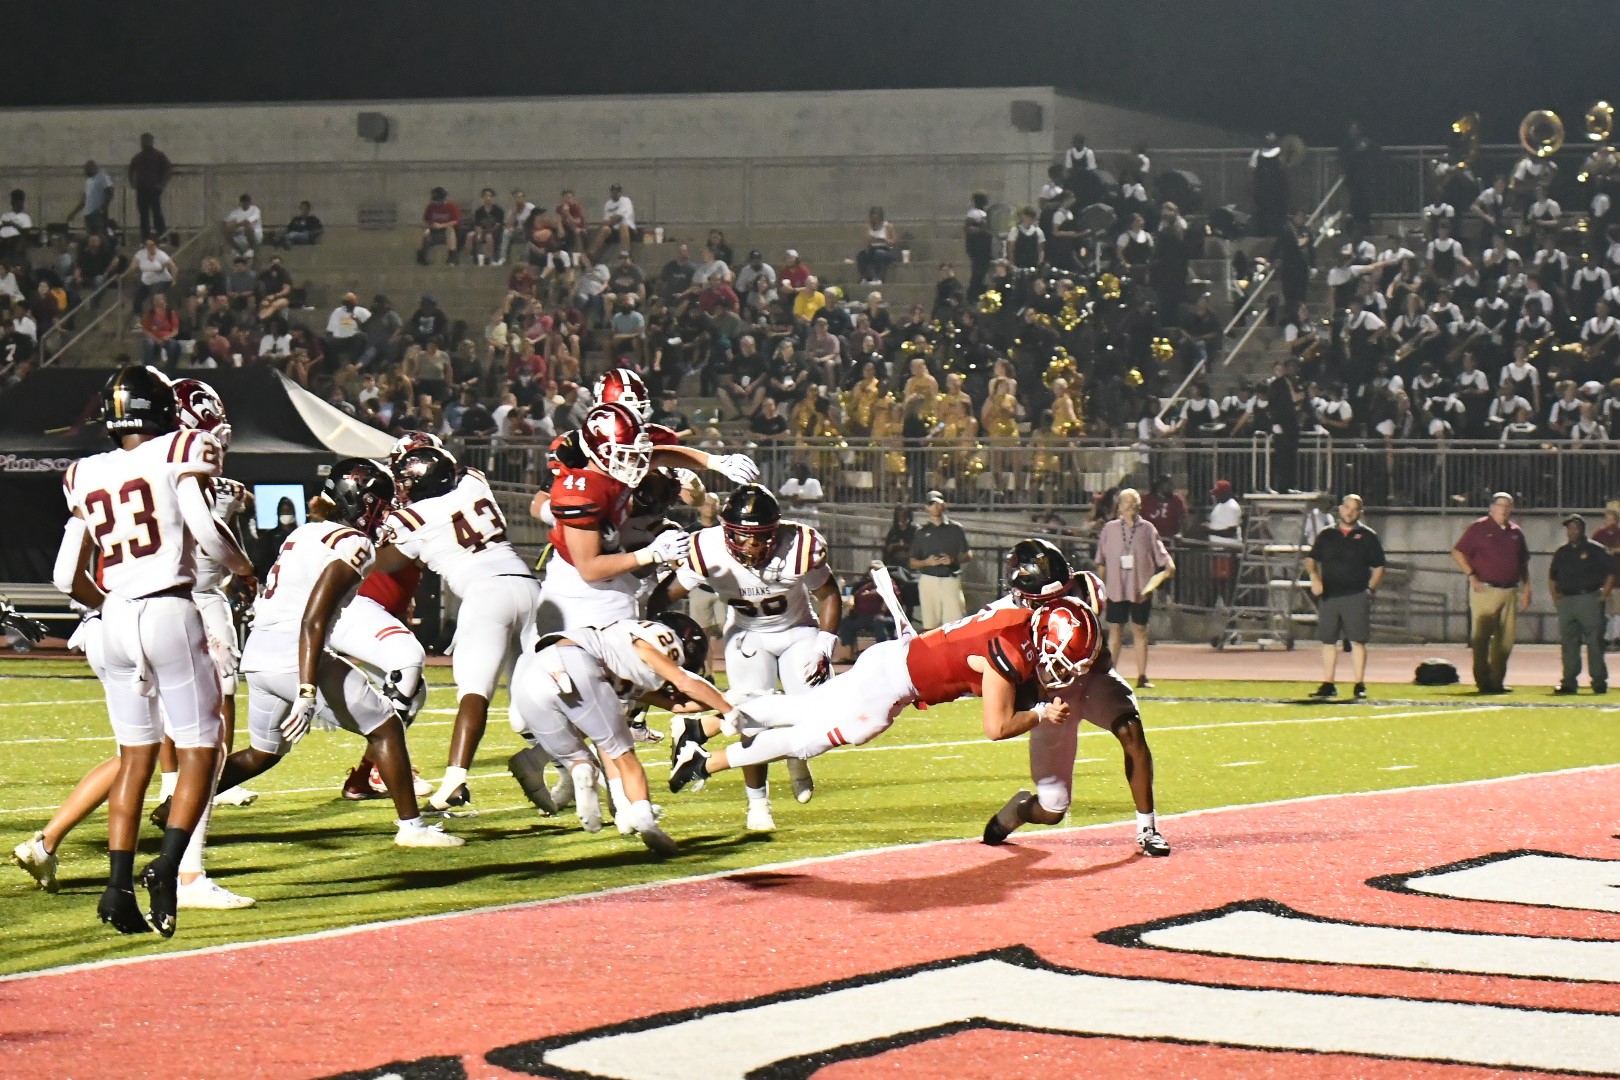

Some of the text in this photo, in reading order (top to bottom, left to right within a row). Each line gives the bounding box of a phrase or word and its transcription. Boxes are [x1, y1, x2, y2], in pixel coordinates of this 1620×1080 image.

[106, 418, 143, 429] Riddell
[563, 474, 586, 491] 44
[85, 477, 162, 568] 23
[451, 497, 507, 554] 43
[350, 546, 369, 568] 5
[739, 587, 771, 597] INDIANS
